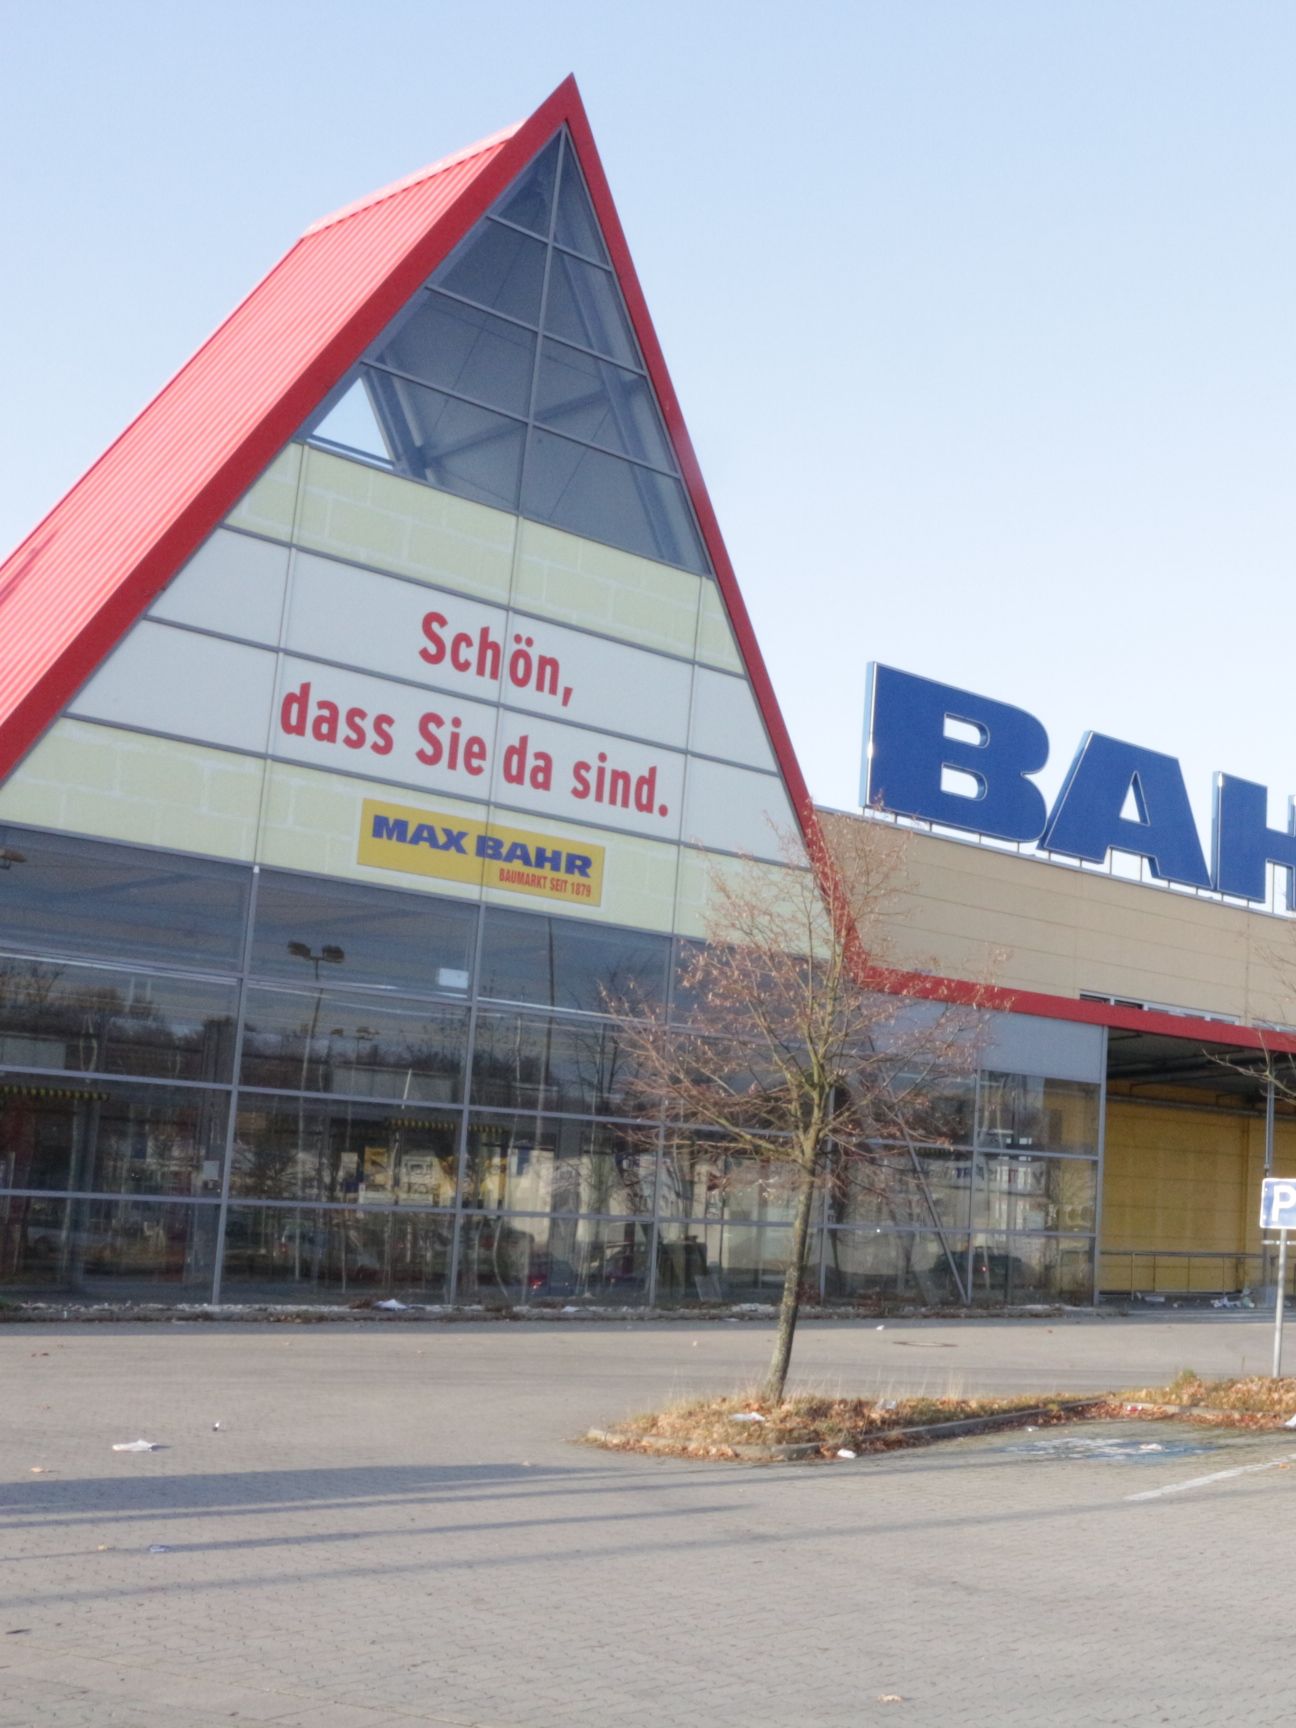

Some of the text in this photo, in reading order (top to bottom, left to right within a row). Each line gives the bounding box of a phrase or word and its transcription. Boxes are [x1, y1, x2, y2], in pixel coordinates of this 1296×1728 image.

[418, 611, 574, 707] Schön,
[280, 681, 669, 817] dass Sie da sind.
[371, 814, 593, 878] MAX BAHR
[498, 868, 592, 898] BAUMARKT SEIT 1879
